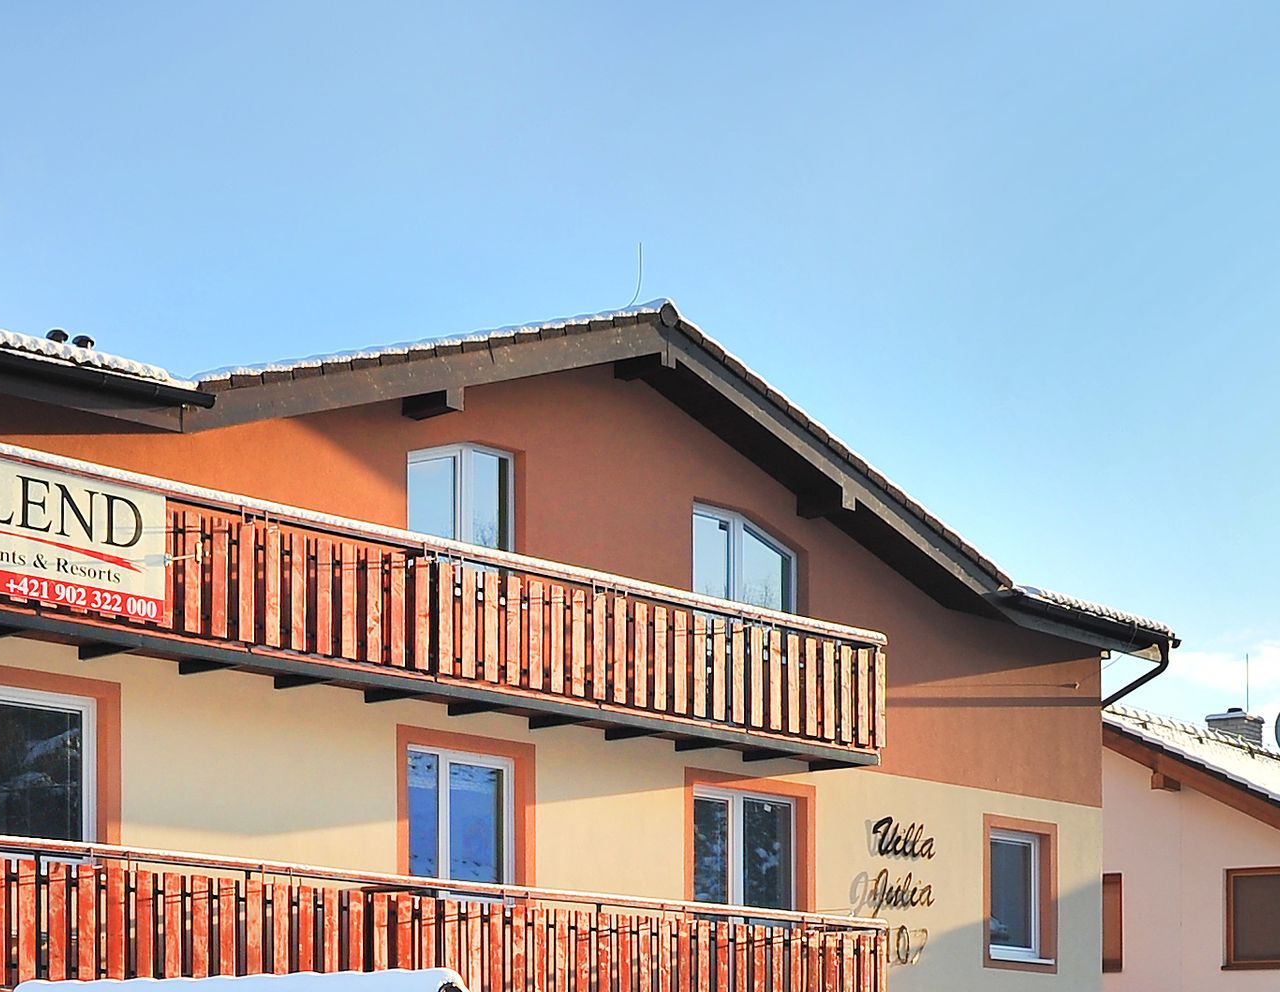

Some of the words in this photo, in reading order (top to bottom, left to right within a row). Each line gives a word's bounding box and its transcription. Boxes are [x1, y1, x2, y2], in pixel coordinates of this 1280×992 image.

[32, 553, 48, 570] &
[56, 557, 121, 584] Resorts
[5, 577, 50, 599] +421
[54, 583, 87, 606] 902
[91, 590, 123, 613] 322
[126, 596, 157, 618] 000
[872, 816, 937, 860] Villa
